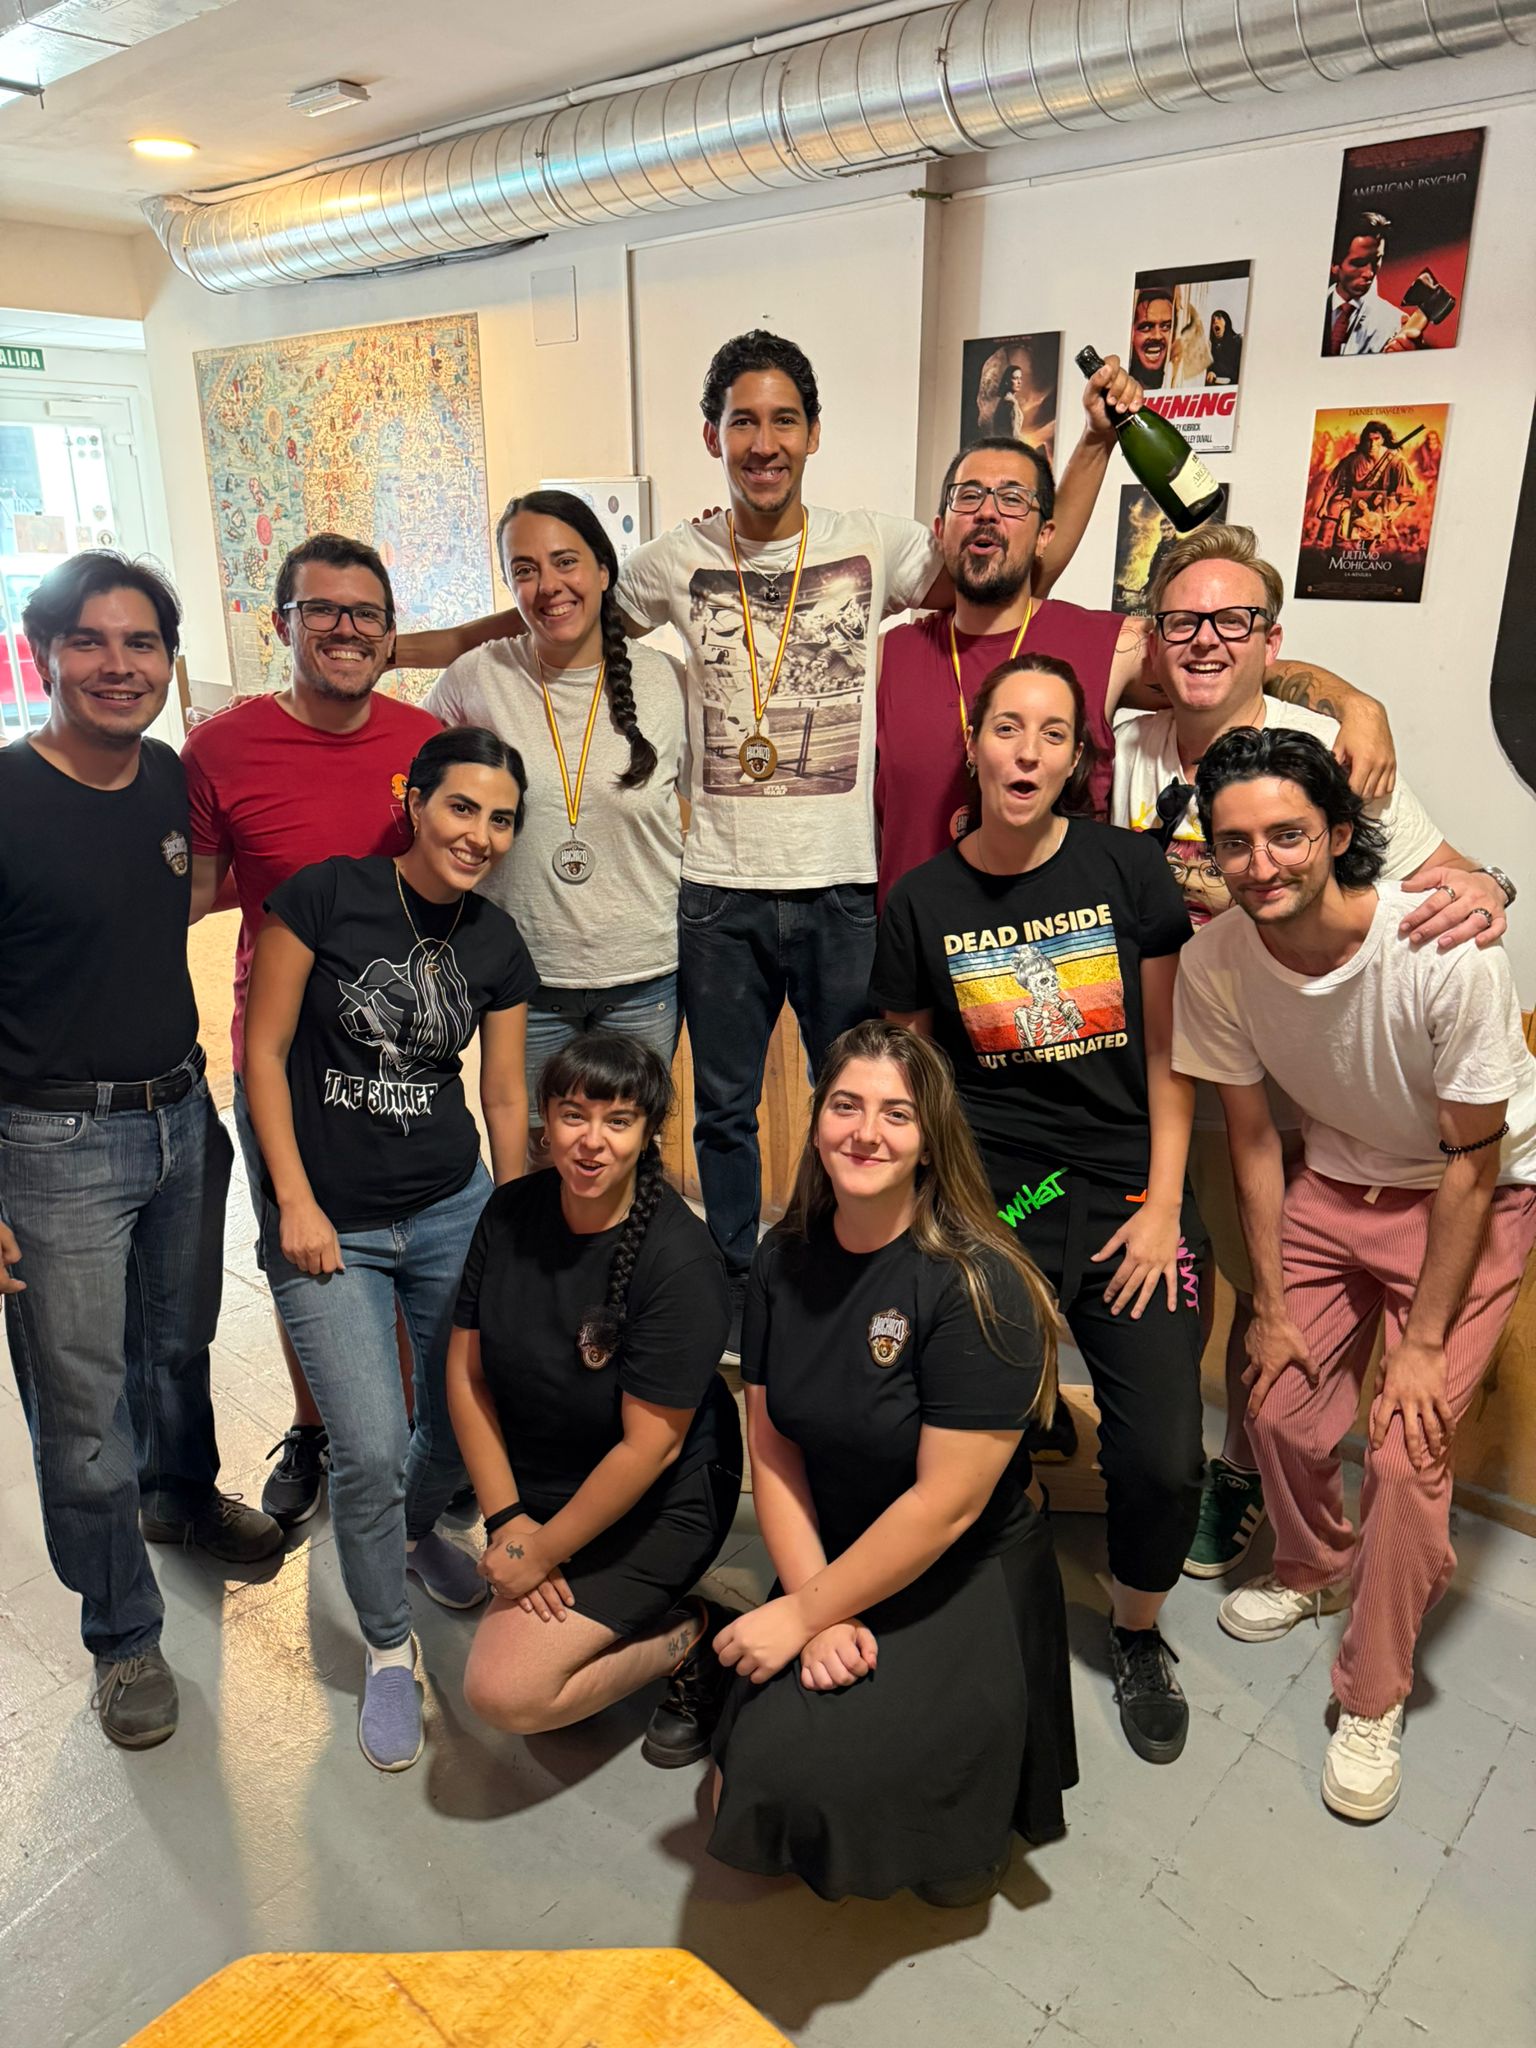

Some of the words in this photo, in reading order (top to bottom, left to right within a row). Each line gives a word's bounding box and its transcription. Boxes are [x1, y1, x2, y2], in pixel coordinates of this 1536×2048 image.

[1352, 180, 1414, 197] AMERICAN
[1417, 172, 1467, 189] PSYCHO
[0, 349, 41, 368] ALIDA
[943, 926, 1018, 956] DEAD
[1023, 904, 1113, 943] INSIDE
[977, 1053, 1008, 1070] BUT
[1011, 1032, 1129, 1064] CAFFEINATED
[324, 1069, 365, 1110] THE
